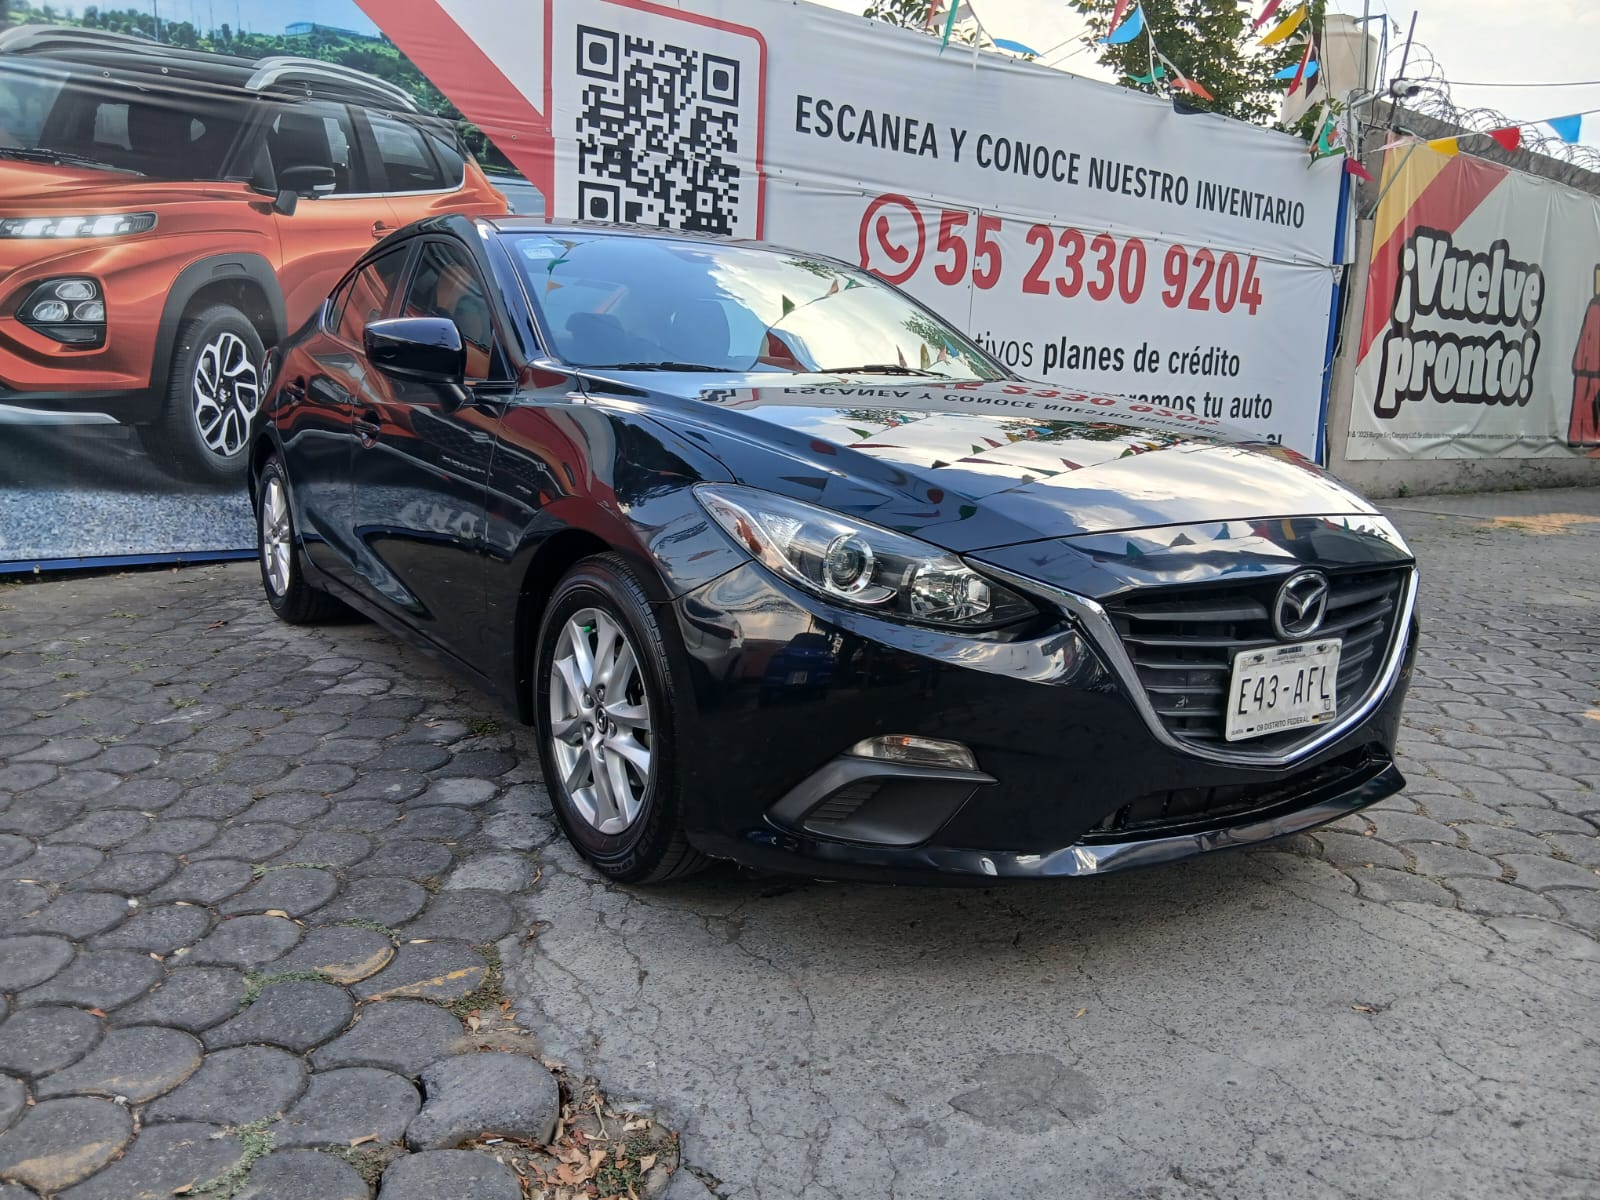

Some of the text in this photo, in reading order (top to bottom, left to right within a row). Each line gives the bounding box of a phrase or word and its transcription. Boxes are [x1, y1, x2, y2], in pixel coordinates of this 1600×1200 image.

[795, 94, 1305, 229] ESCANEA Y CONOCE NUESTRO INVENTARIO
[935, 210, 1263, 316] 55 2330 9204
[1393, 230, 1543, 325] ¡Vuelve
[1042, 336, 1125, 375] planes
[1133, 342, 1160, 373] de
[1168, 346, 1240, 377] crédito
[1376, 332, 1539, 414] pronto!
[1203, 391, 1223, 418] tu
[1229, 393, 1273, 419] auto
[1238, 665, 1330, 715] E43-AFL
